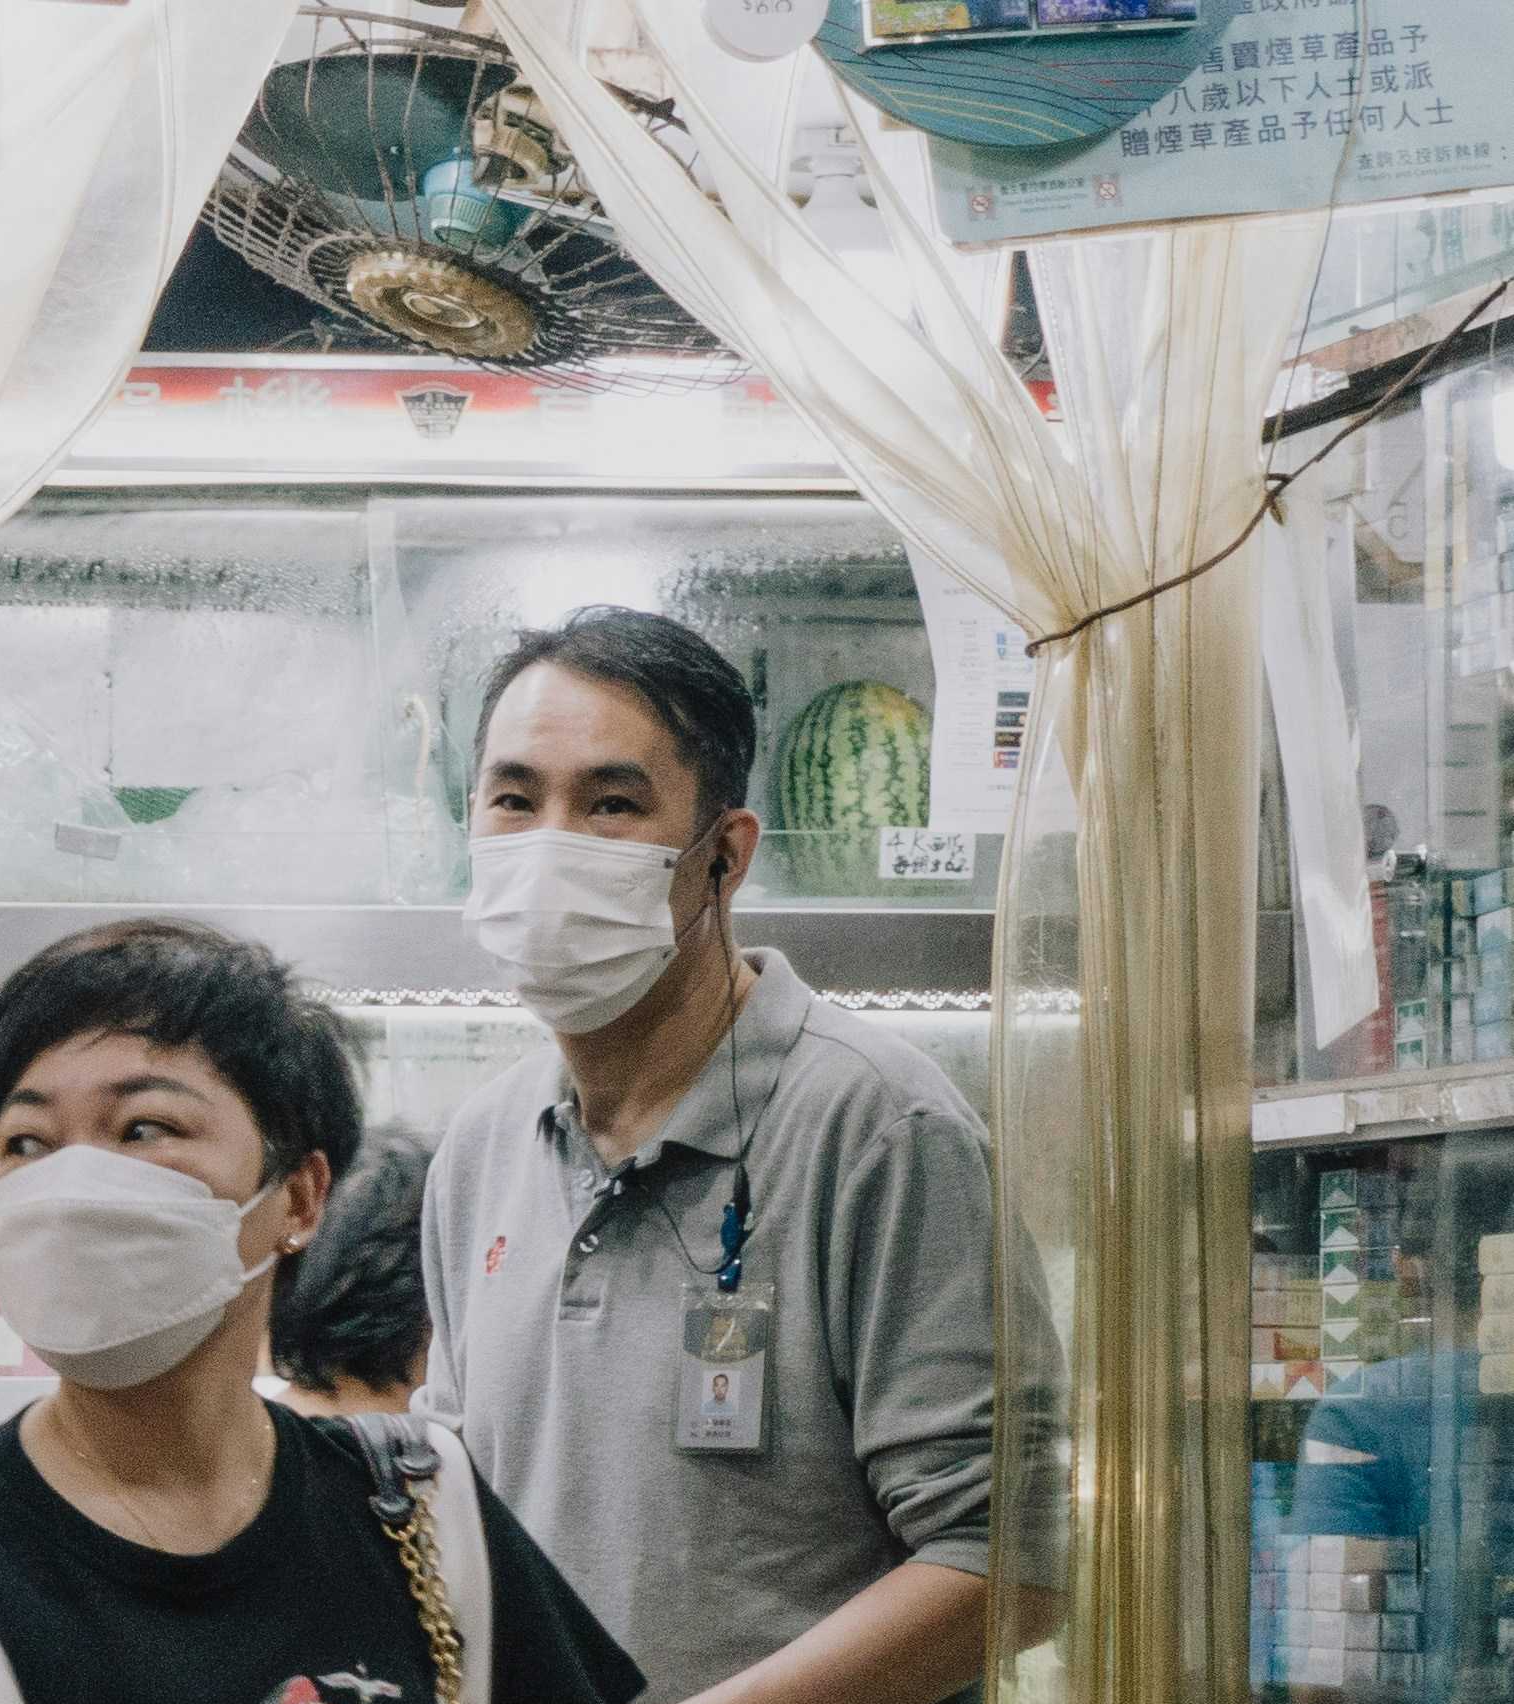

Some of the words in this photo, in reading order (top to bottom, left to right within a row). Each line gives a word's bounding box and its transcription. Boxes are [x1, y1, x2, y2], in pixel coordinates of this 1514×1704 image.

[1121, 96, 1454, 159] 贈煙草產品予任何人士
